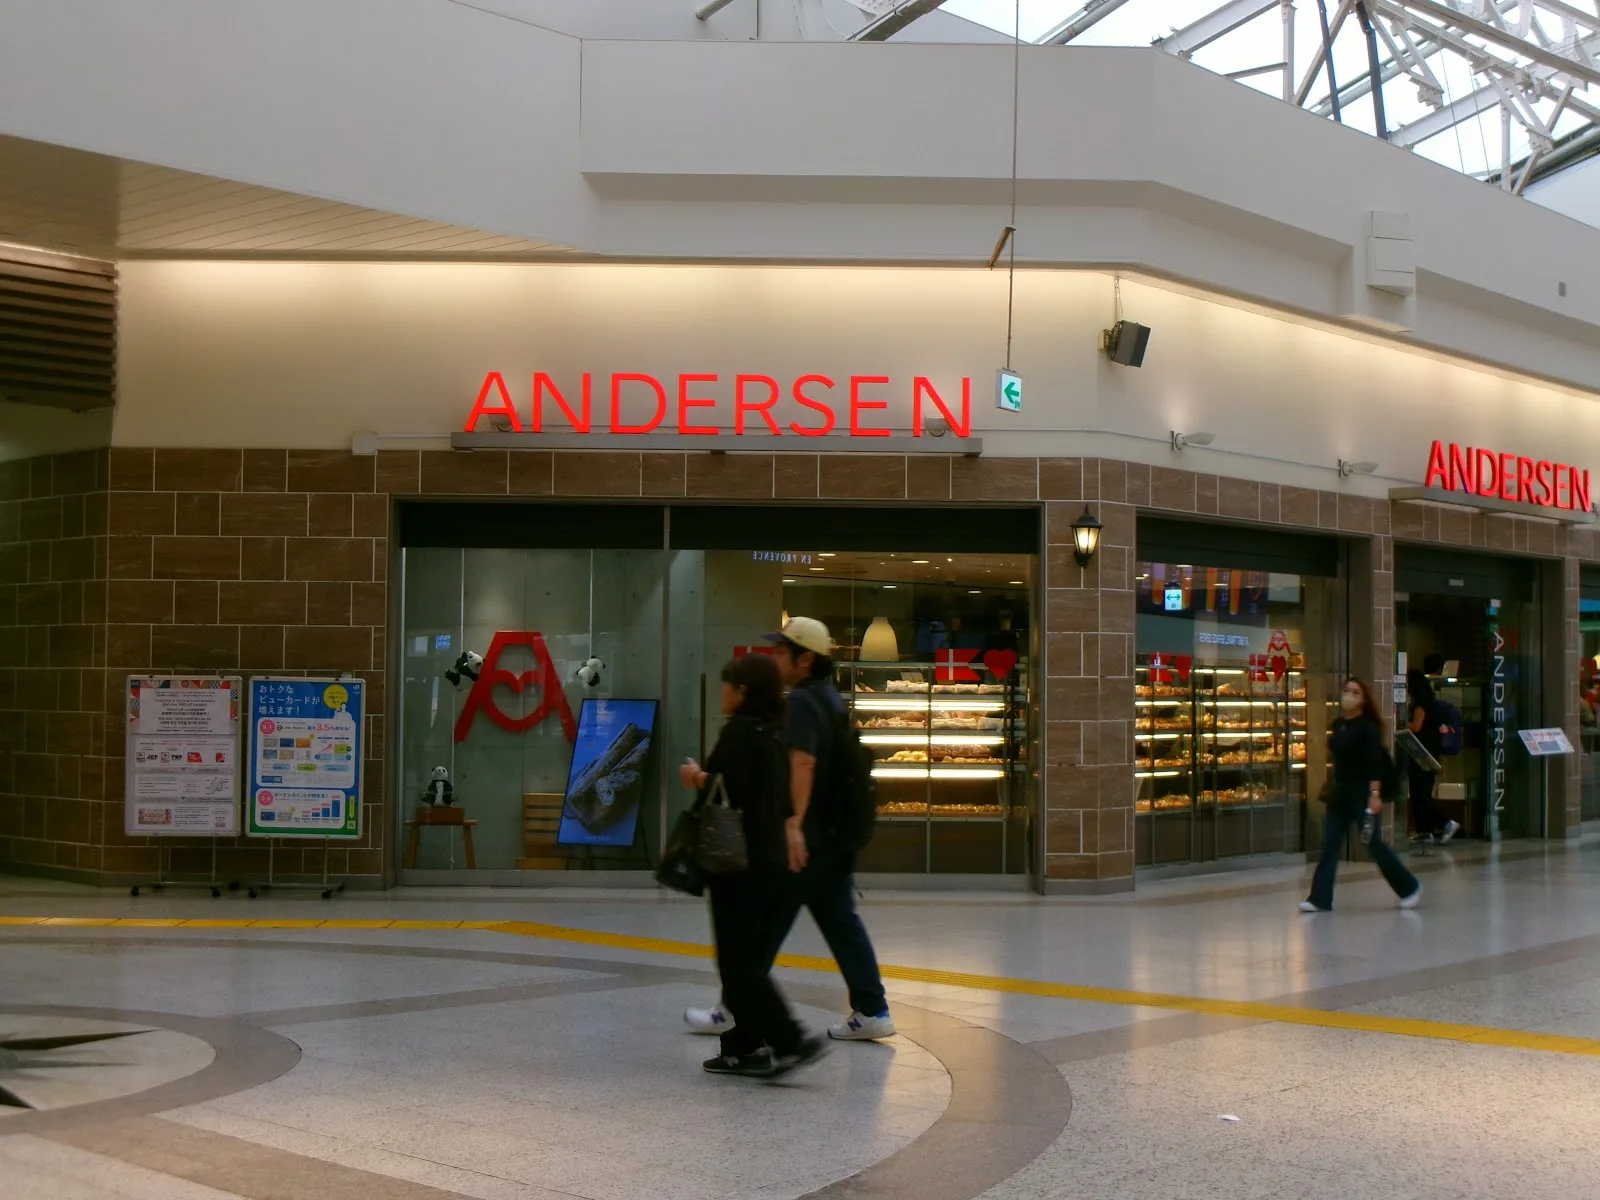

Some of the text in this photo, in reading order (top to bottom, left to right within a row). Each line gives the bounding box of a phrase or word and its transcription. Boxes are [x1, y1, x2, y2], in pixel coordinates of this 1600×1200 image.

[464, 371, 971, 437] ANDERSEN
[1425, 440, 1592, 512] ANDERSEN
[259, 684, 295, 693] おトクな
[259, 695, 321, 705] ビューカードが
[1493, 631, 1505, 810] ANDERSEN
